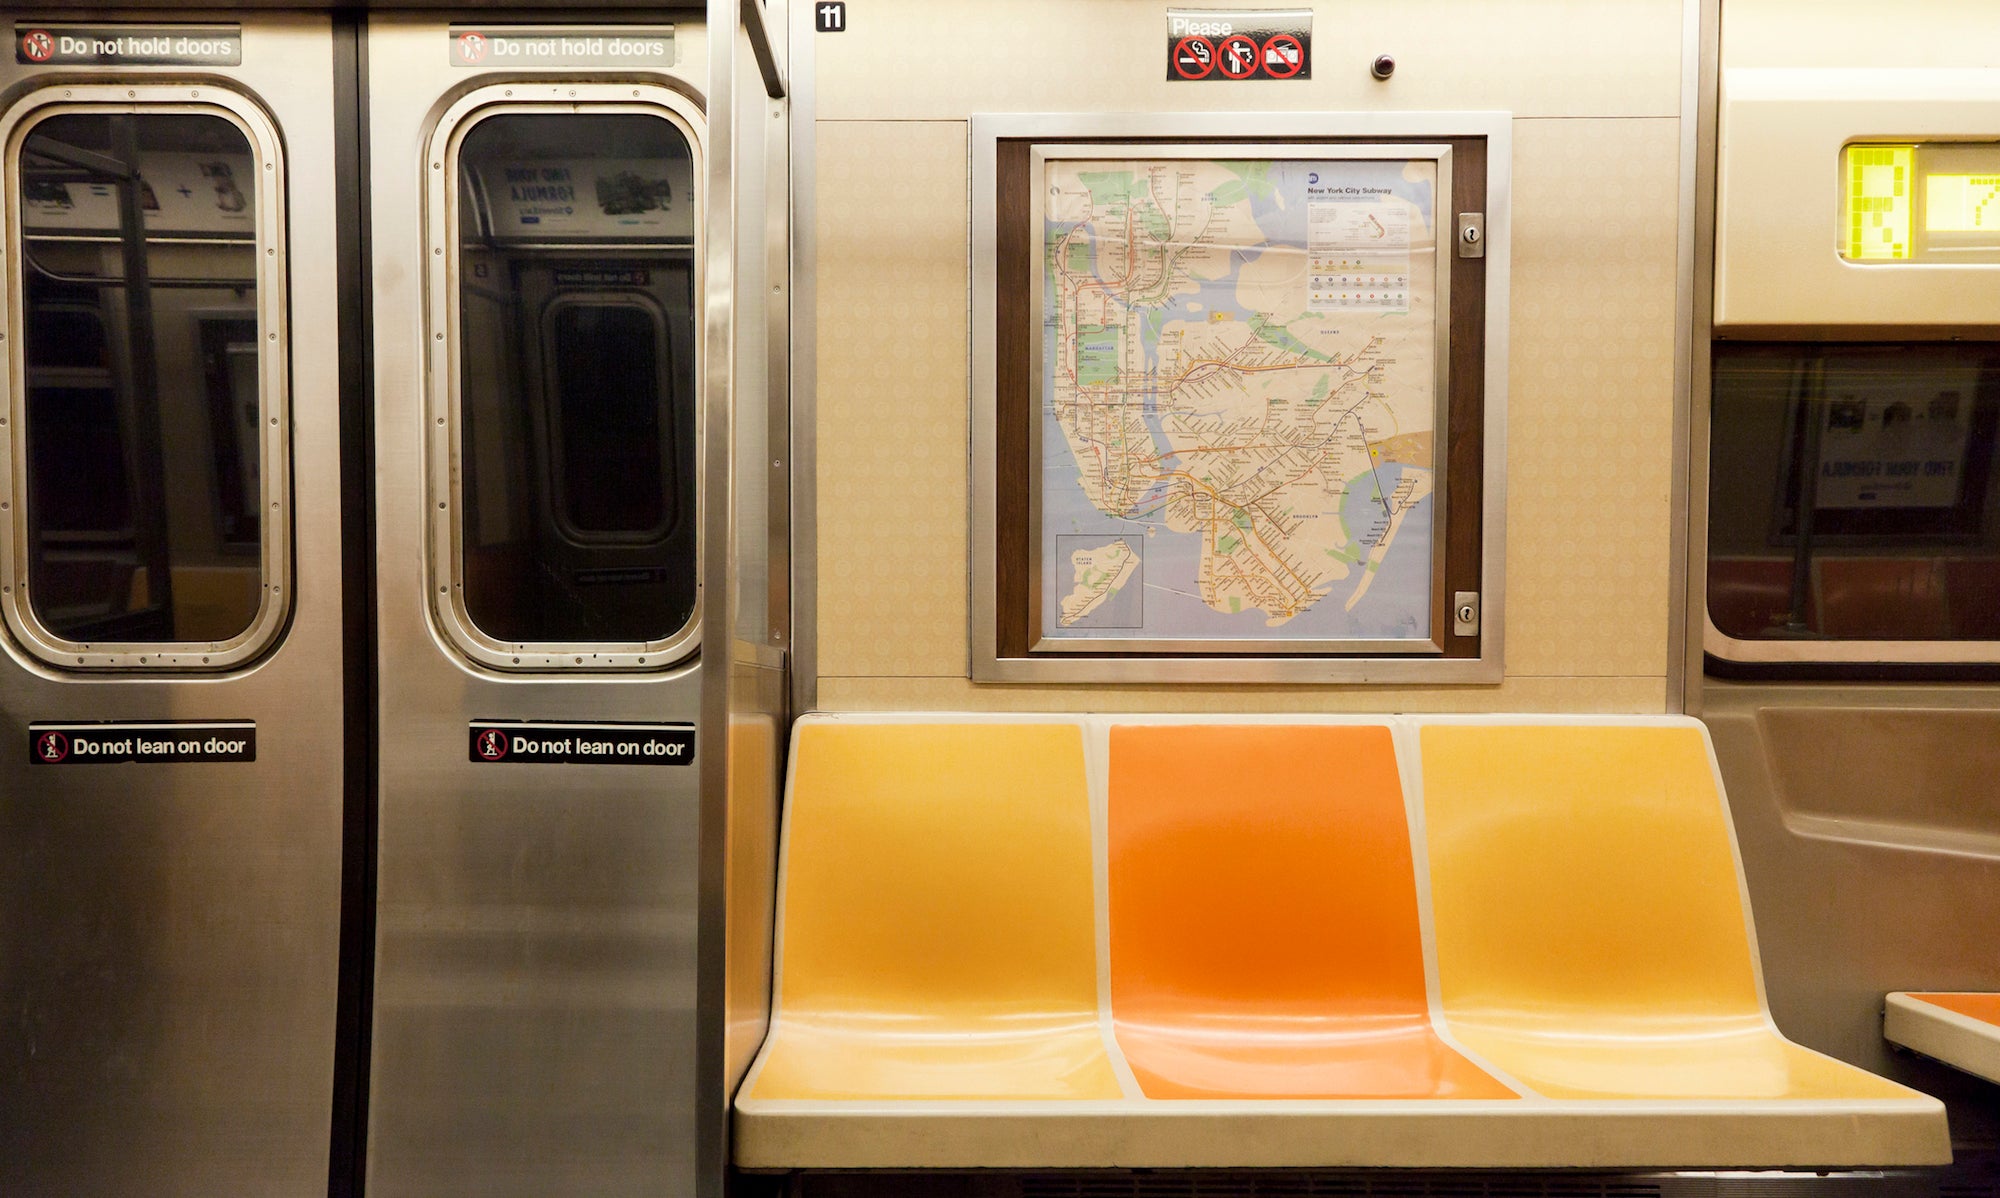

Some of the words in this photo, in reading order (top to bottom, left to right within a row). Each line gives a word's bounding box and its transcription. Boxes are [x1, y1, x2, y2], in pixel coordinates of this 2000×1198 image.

[819, 5, 841, 28] 11
[1172, 18, 1233, 36] Please
[60, 36, 87, 55] Do
[92, 37, 124, 55] not
[128, 36, 170, 55] hold
[175, 36, 232, 55] doors
[493, 38, 520, 56] Do
[525, 39, 557, 56] not
[561, 38, 603, 56] hold
[607, 38, 664, 56] doors
[1345, 187, 1361, 195] City
[1362, 187, 1392, 195] Subway
[1851, 150, 1904, 259] R
[73, 738, 100, 755] Do
[102, 738, 133, 755] not
[136, 737, 175, 755] lean
[177, 740, 201, 754] on
[203, 736, 246, 754] door
[512, 736, 539, 754] Do
[541, 737, 572, 754] not
[575, 737, 614, 755] lean
[616, 741, 640, 755] on
[642, 738, 685, 756] door
